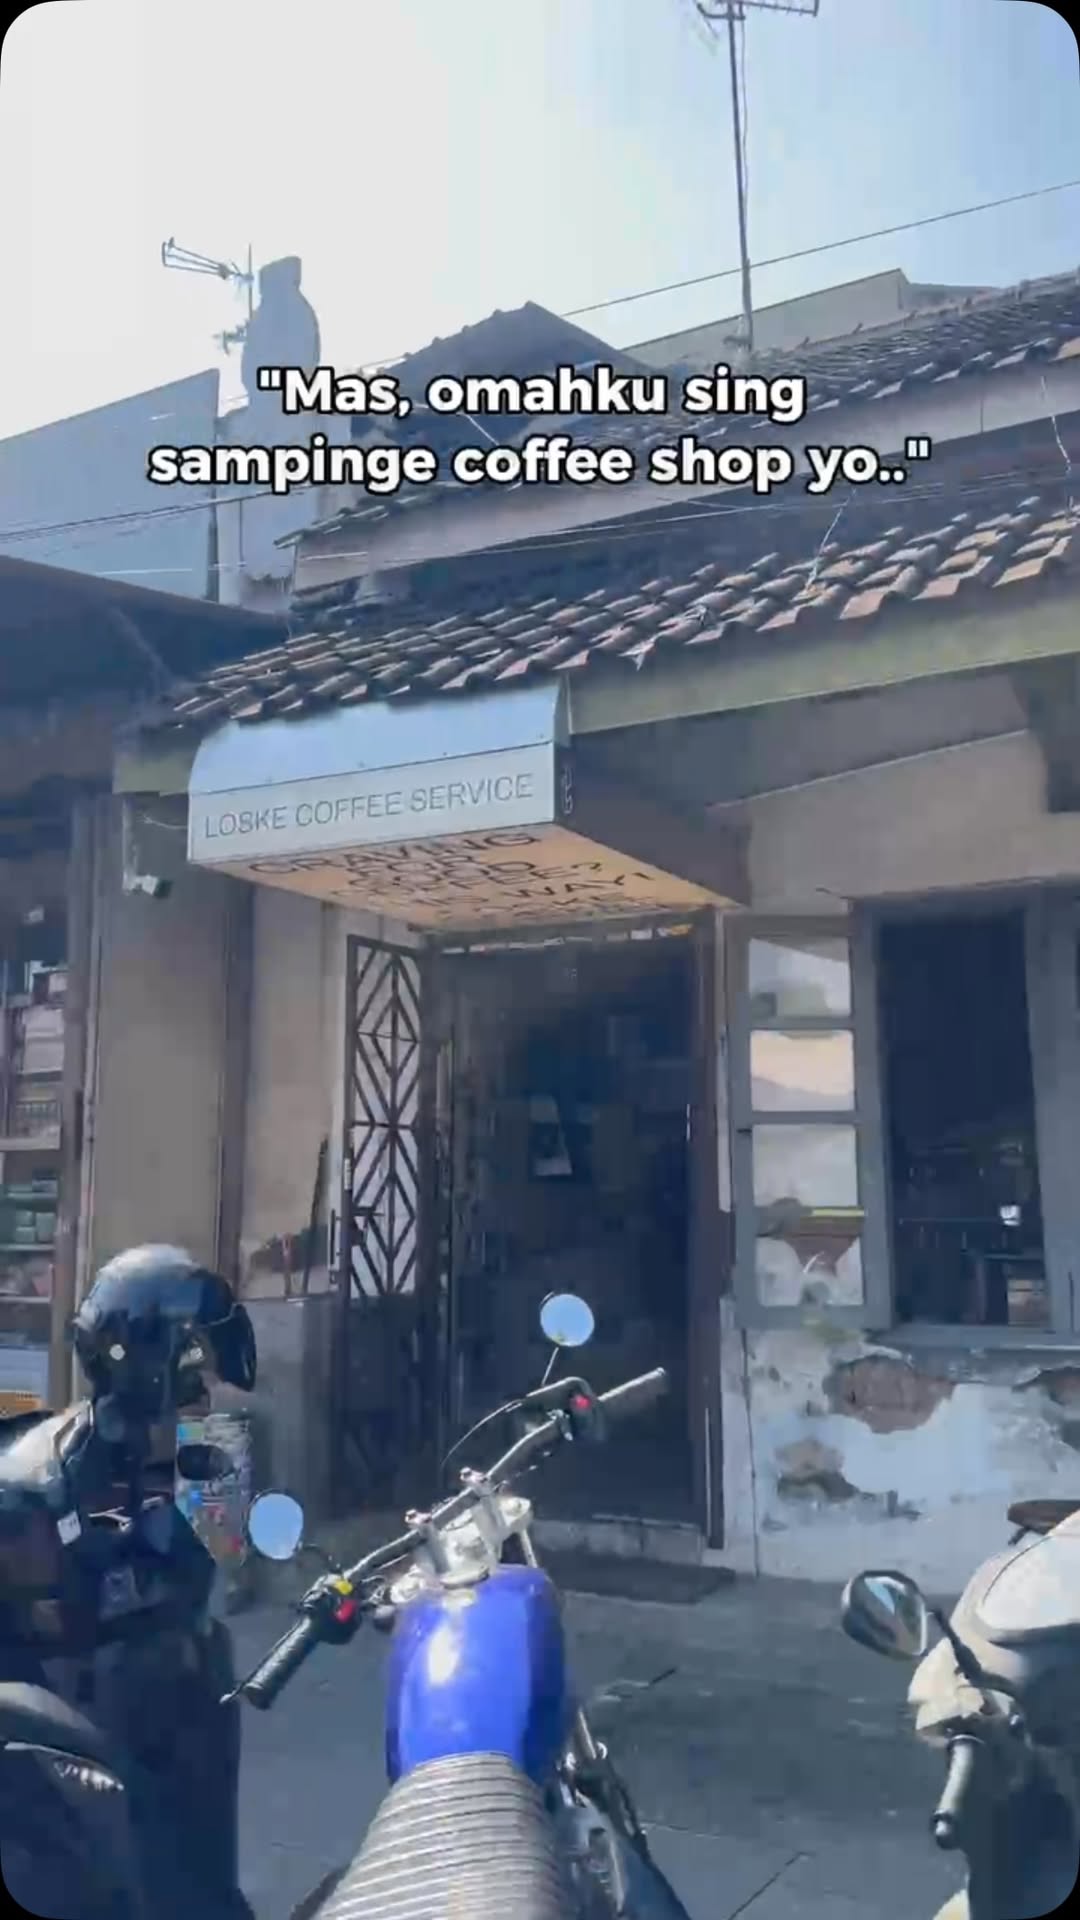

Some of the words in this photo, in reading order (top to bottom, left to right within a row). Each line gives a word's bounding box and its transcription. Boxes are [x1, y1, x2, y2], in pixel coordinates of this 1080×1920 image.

[205, 806, 288, 839] LOSKE
[295, 791, 403, 827] COFFEE
[410, 772, 534, 813] SERVICE
[249, 832, 541, 874] CRAVING
